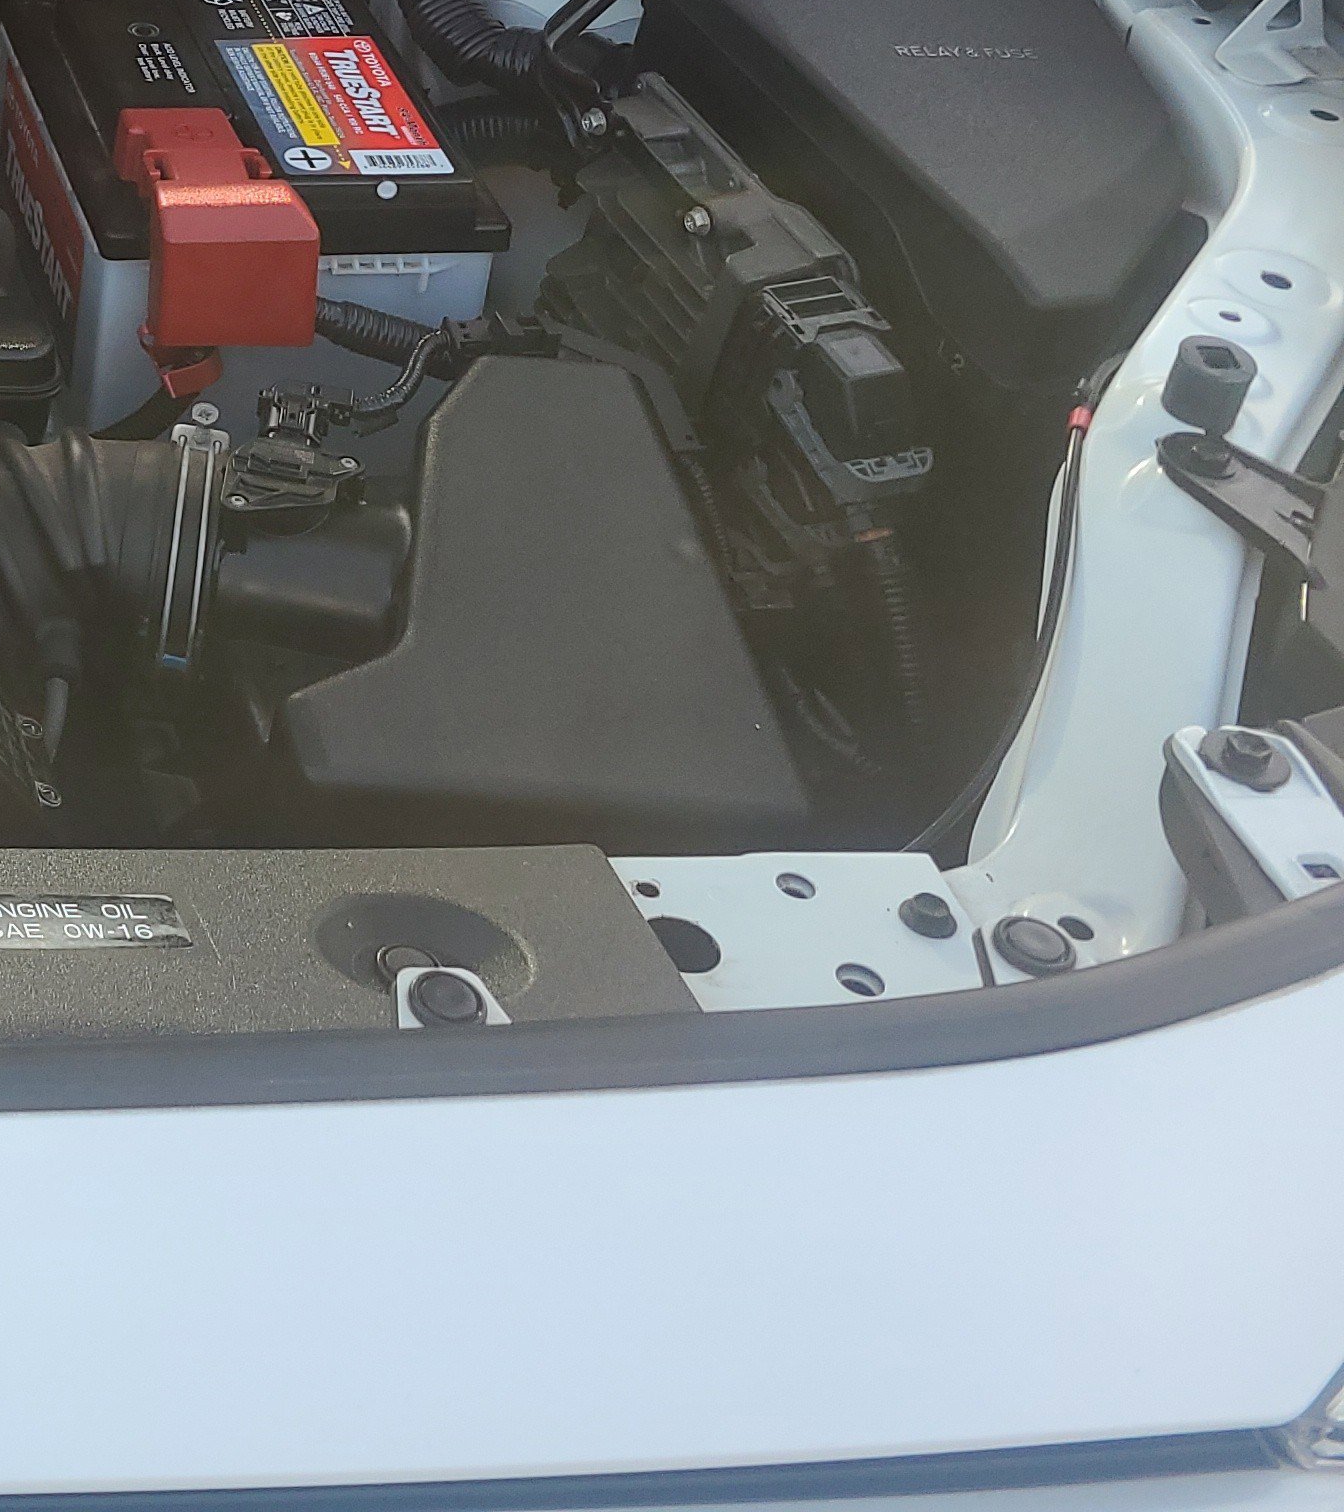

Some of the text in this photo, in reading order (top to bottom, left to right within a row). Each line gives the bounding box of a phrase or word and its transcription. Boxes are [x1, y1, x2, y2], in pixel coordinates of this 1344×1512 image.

[894, 45, 963, 58] RELAY
[984, 47, 1038, 60] FUSE
[363, 52, 392, 87] TOYOTA
[100, 902, 149, 920] OIL
[64, 923, 154, 940] 0W-16
